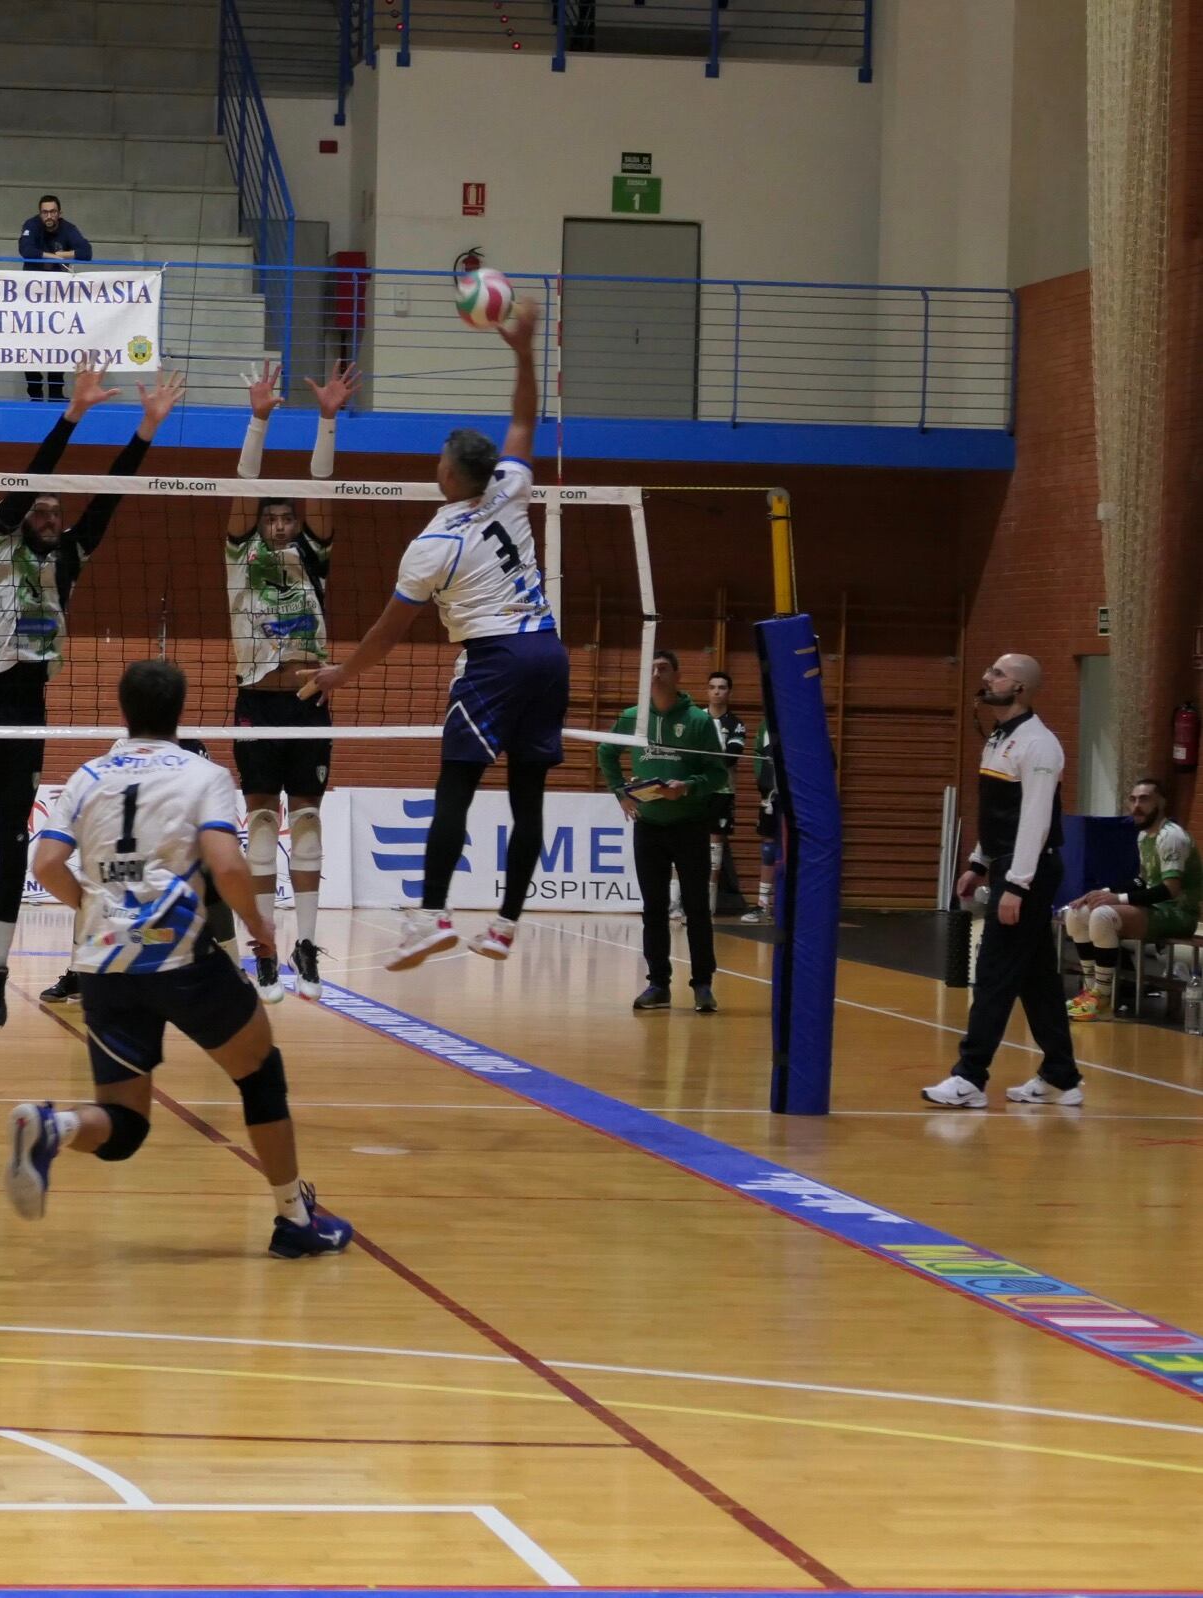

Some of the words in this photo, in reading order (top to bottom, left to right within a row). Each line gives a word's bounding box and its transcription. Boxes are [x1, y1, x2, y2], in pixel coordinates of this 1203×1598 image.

[25, 279, 153, 304] GIMNASIA
[0, 347, 123, 365] BENIDORM
[148, 479, 217, 491] rfevb.com
[334, 484, 403, 496] rfevb.com
[482, 520, 522, 574] 3
[115, 783, 142, 853] 1
